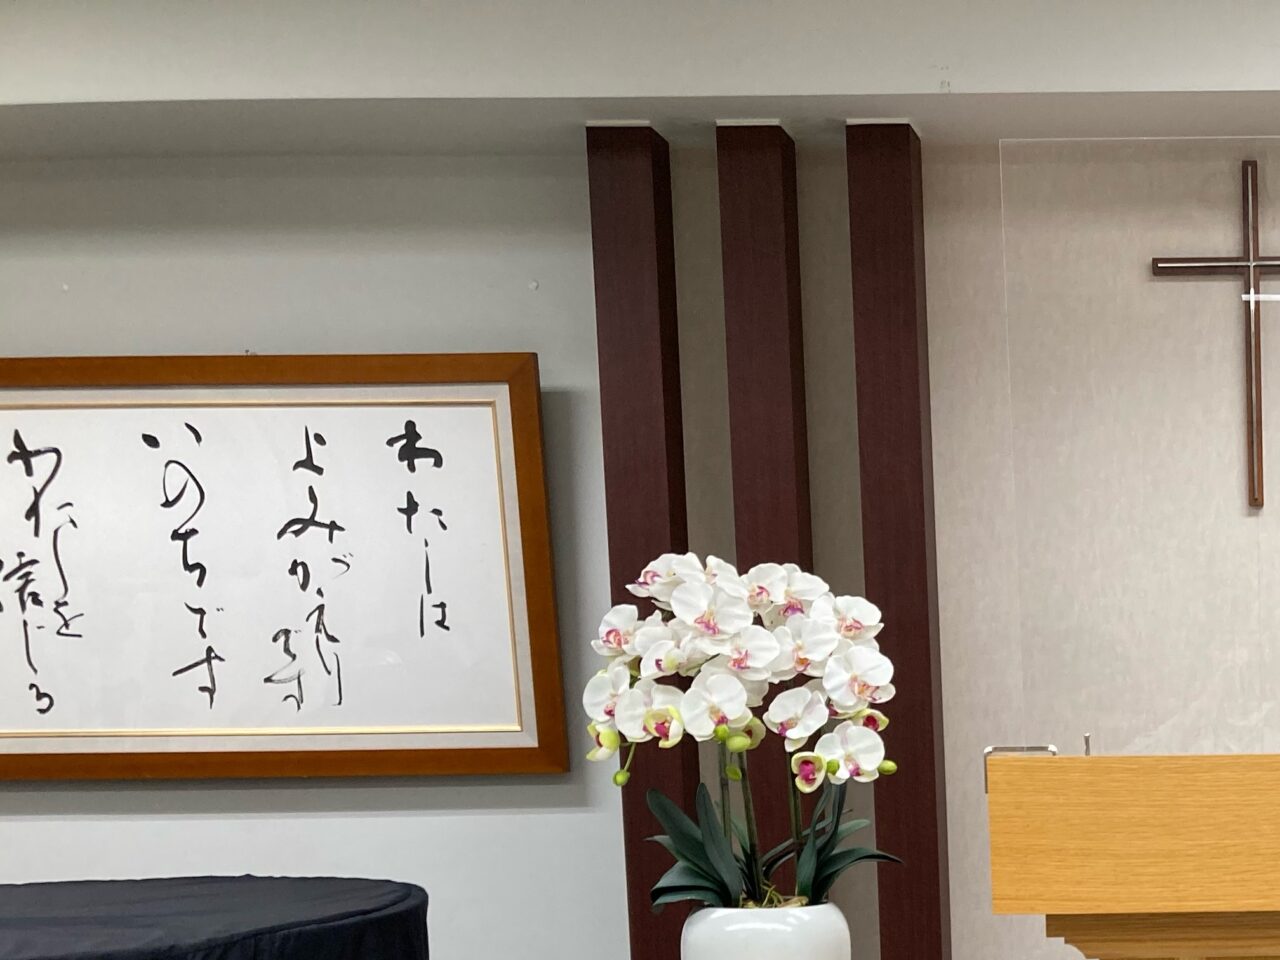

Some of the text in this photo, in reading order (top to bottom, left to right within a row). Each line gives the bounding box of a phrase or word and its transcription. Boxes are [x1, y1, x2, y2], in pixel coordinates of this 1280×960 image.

[141, 422, 226, 710] いのちです
[386, 420, 450, 638] わたしは
